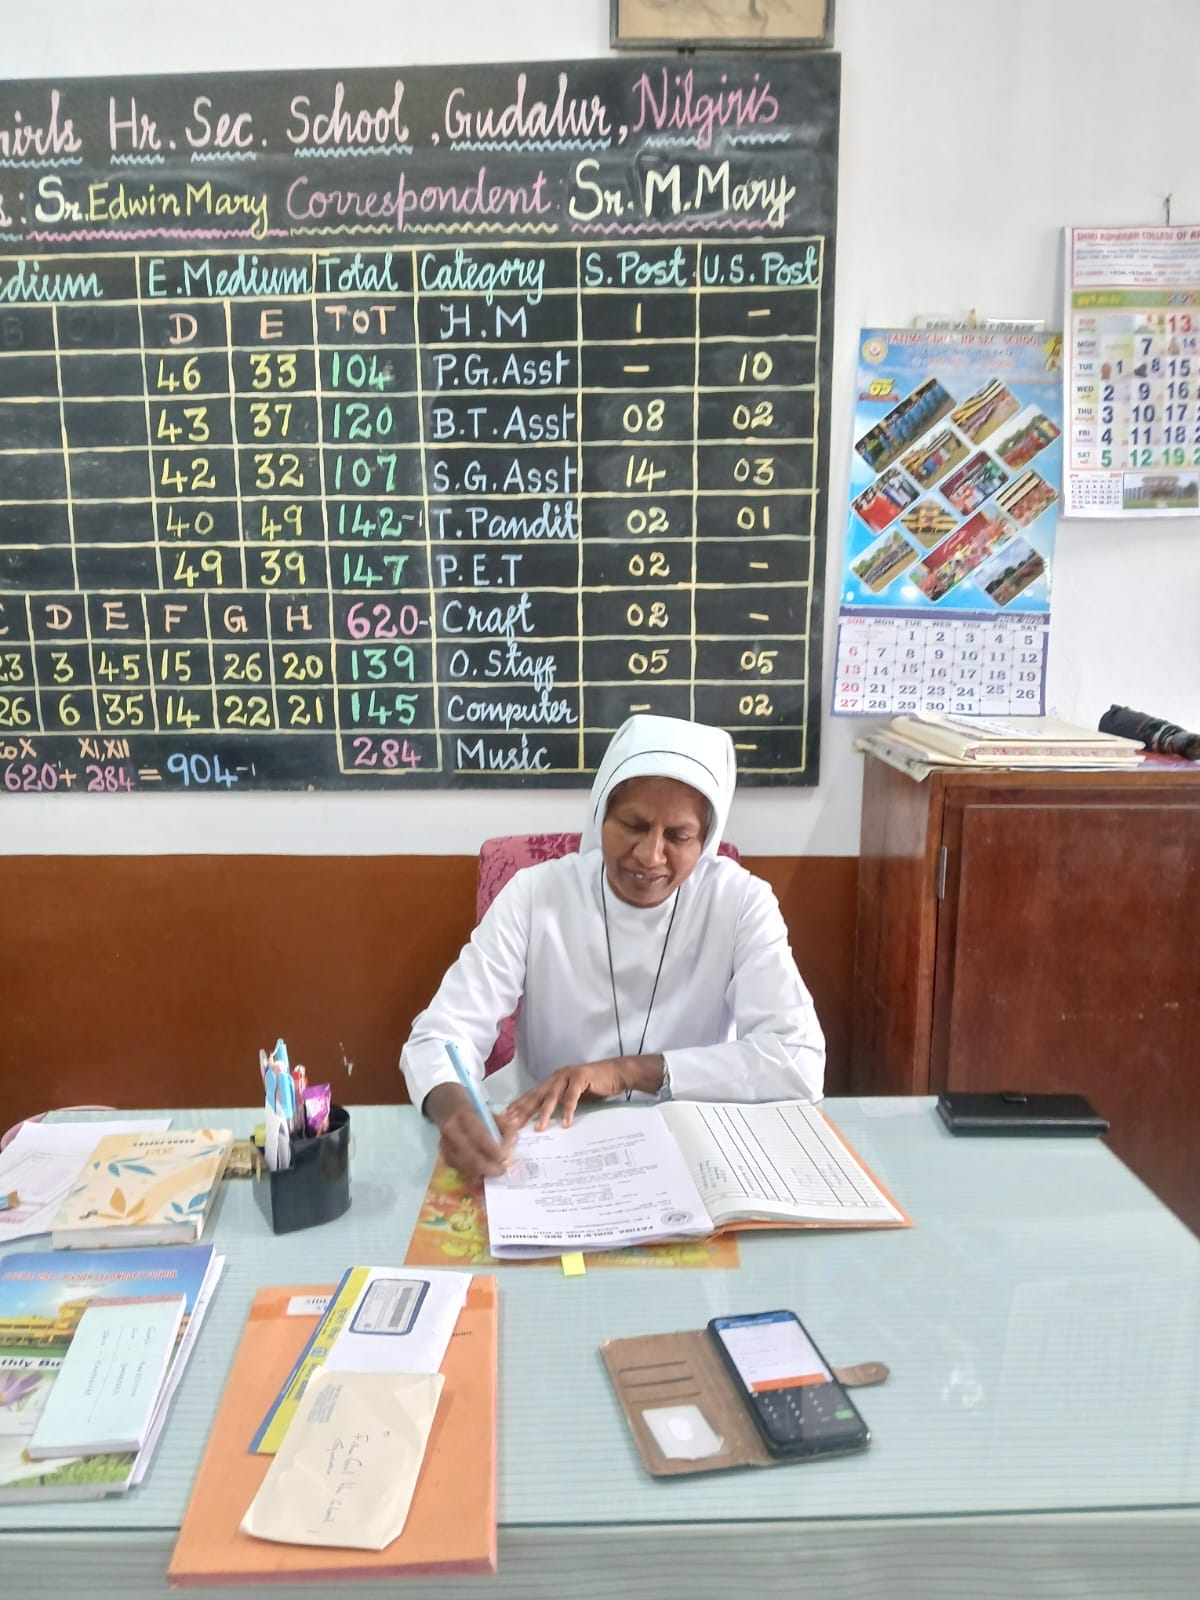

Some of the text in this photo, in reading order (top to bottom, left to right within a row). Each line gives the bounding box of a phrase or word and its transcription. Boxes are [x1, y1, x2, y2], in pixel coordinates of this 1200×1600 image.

[110, 96, 176, 151] Hr.
[185, 96, 267, 147] Sec.
[286, 80, 409, 143] School
[632, 67, 779, 148] Nilgiris
[185, 181, 269, 240] Mary
[569, 158, 633, 221] Sr.
[0, 258, 102, 301] dium
[318, 251, 398, 293] Total
[421, 248, 545, 305] Category
[168, 312, 198, 344] D
[259, 308, 284, 340] E
[1142, 338, 1152, 355] 7
[157, 356, 202, 392] 46
[249, 353, 298, 387] 33
[331, 352, 394, 391] 104
[738, 351, 773, 384] 10
[1168, 359, 1191, 377] 15
[1104, 384, 1114, 401] 2
[1139, 383, 1150, 400] 9
[1168, 382, 1189, 399] 16
[157, 406, 210, 443] 43
[249, 402, 293, 438] 37
[332, 403, 394, 439] 120
[622, 398, 666, 433] 08
[732, 401, 774, 430] 02
[1102, 406, 1114, 424] 3
[1132, 405, 1155, 424] 10
[1165, 404, 1188, 421] 17
[1101, 428, 1113, 446] 4
[1131, 427, 1151, 445] 11
[1164, 426, 1185, 444] 18
[254, 453, 304, 489] 32
[335, 453, 398, 492] 107
[733, 457, 775, 485] 03
[1101, 450, 1112, 468] 5
[1130, 449, 1152, 466] 12
[1162, 448, 1185, 466] 19
[160, 457, 216, 493] 42
[626, 455, 667, 492] 14
[166, 506, 215, 538] 40
[261, 505, 304, 540] 49
[626, 506, 670, 534] 02
[736, 506, 771, 530] 01
[173, 551, 224, 588] 49
[261, 549, 306, 586] 39
[343, 554, 410, 587] 147
[628, 552, 671, 578] 02
[45, 604, 73, 630] D
[102, 602, 129, 631] E
[164, 604, 188, 633] F
[223, 605, 248, 633] G
[286, 605, 313, 632] H
[441, 591, 535, 646] Craft
[626, 602, 669, 629] 02
[909, 632, 915, 640] 1
[936, 632, 945, 641] 2
[994, 633, 1003, 643] 4
[1024, 636, 1033, 644] 5
[51, 651, 74, 683] 3
[98, 653, 140, 682] 45
[161, 649, 191, 681] 15
[223, 653, 263, 681] 26
[282, 654, 324, 681] 20
[351, 645, 415, 682] 139
[628, 649, 670, 674] 05
[739, 650, 779, 675] 05
[849, 648, 858, 656] 6
[877, 648, 886, 657] 7
[934, 650, 944, 659] 9
[961, 651, 978, 660] 10
[1020, 653, 1038, 663] 12
[844, 665, 1036, 681] 13 14 15 16 17 18 19
[738, 693, 773, 717] 02
[840, 699, 974, 711] 27 28 29 30 31
[841, 683, 1035, 699] 20 21 22 23 24 25 26
[0, 695, 32, 727] 26
[58, 693, 81, 727] 6
[102, 694, 144, 726] 35
[166, 694, 200, 728] 14
[225, 696, 272, 727] 22
[287, 694, 324, 725] 21
[350, 690, 419, 725] 145
[447, 687, 578, 731] Computer
[353, 736, 421, 768] 284
[456, 734, 552, 770] Music
[85, 764, 135, 793] 284
